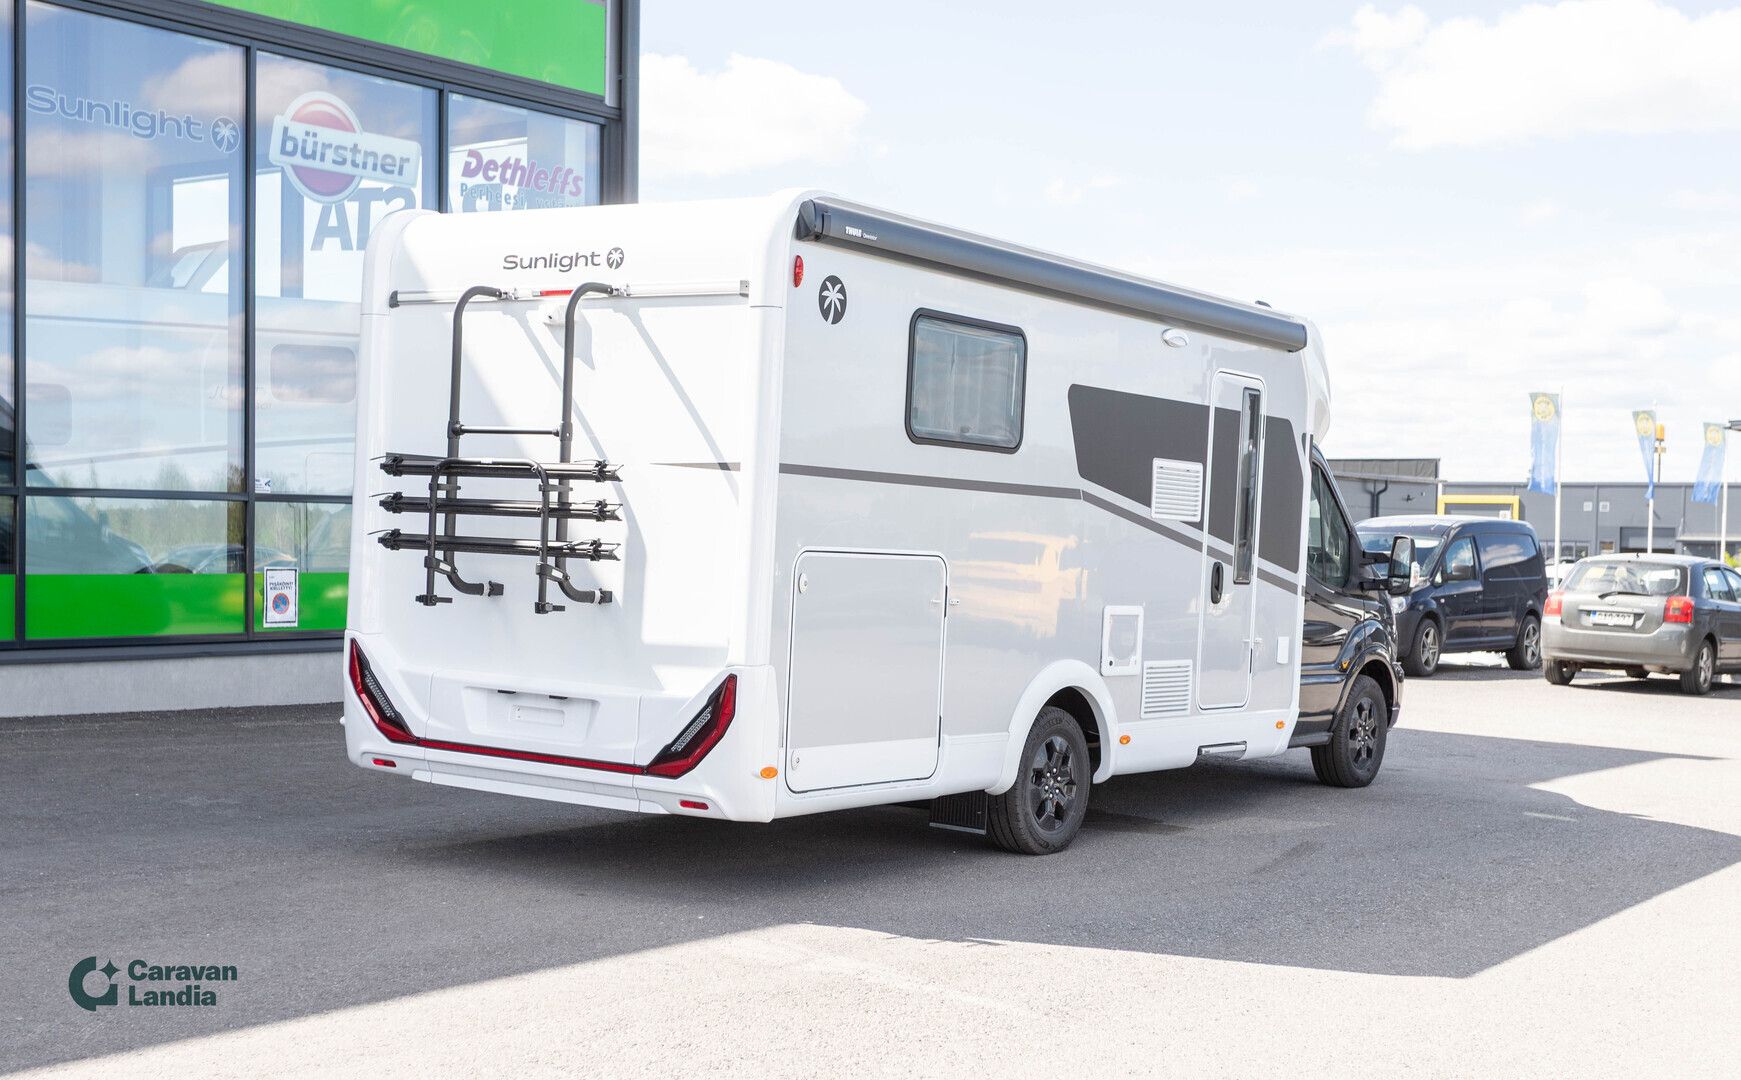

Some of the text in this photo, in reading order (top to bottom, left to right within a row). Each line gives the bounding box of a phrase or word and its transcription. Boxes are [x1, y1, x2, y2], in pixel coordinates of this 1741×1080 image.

[26, 84, 204, 143] Sunlight
[279, 126, 410, 176] bürstner
[461, 149, 583, 197] Dethleffs
[503, 251, 601, 273] Sunlight
